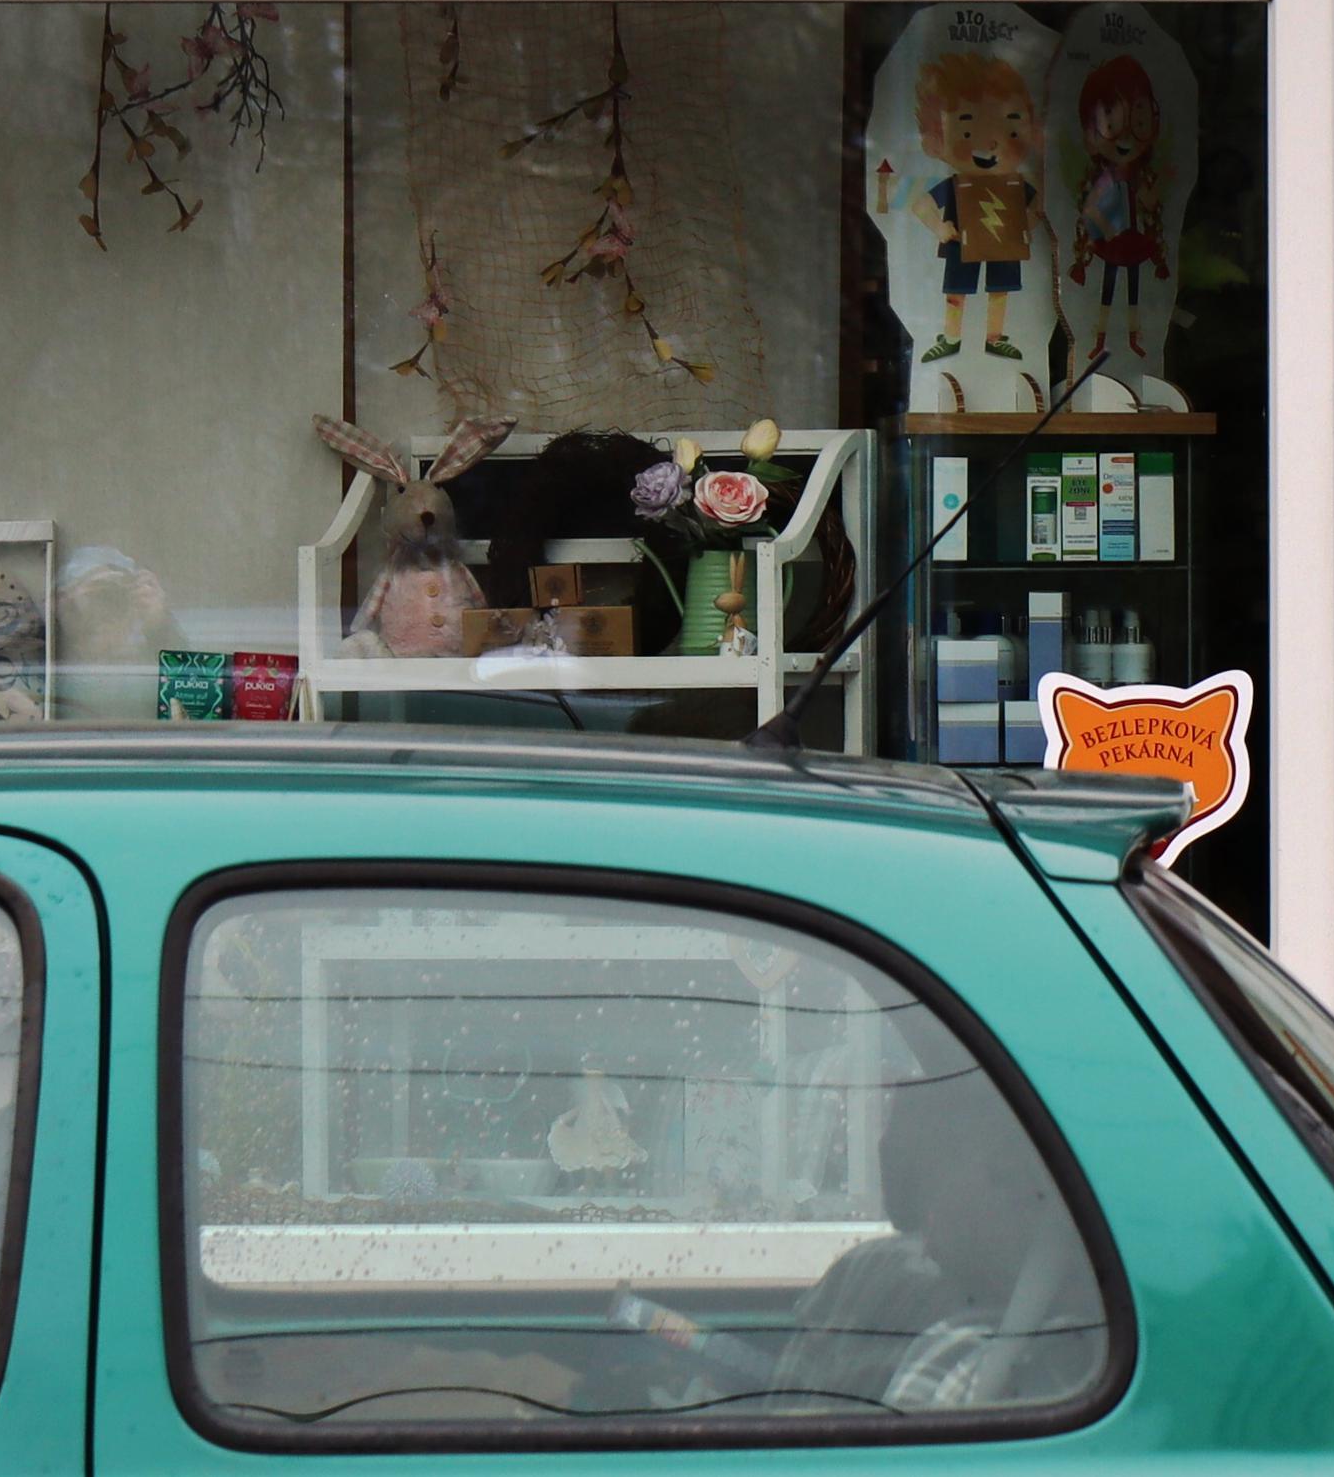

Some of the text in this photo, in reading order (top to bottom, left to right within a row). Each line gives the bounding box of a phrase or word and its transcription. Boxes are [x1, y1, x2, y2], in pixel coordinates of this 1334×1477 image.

[956, 11, 984, 25] BIO
[174, 679, 209, 691] pukka
[244, 681, 275, 692] pukka
[1080, 718, 1217, 751] BEZLEPKOVÁ
[1098, 742, 1195, 768] PEKÁRNA
